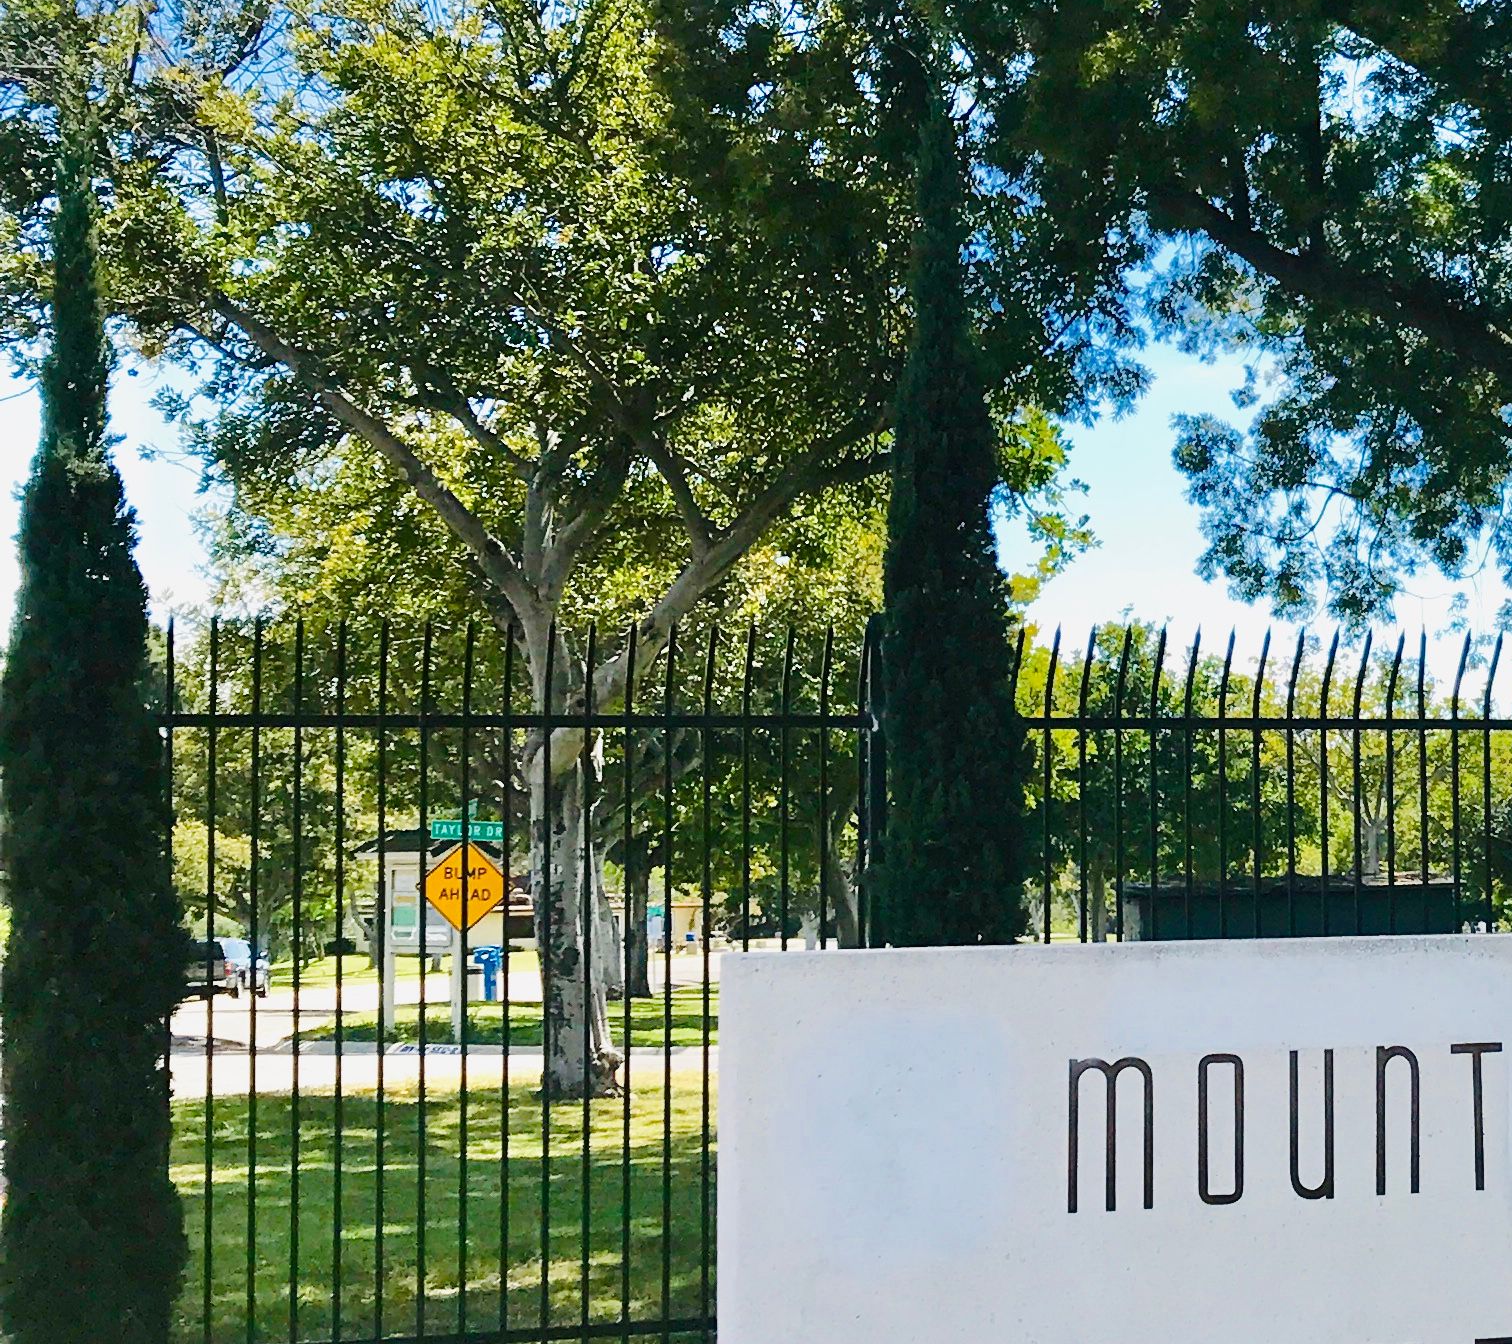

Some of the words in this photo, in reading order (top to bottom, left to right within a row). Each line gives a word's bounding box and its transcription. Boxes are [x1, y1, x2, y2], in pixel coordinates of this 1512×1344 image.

[486, 825, 503, 838] DR
[444, 866, 487, 880] BUMP
[439, 887, 491, 902] AHAD
[1066, 1041, 1504, 1215] MOUNT
